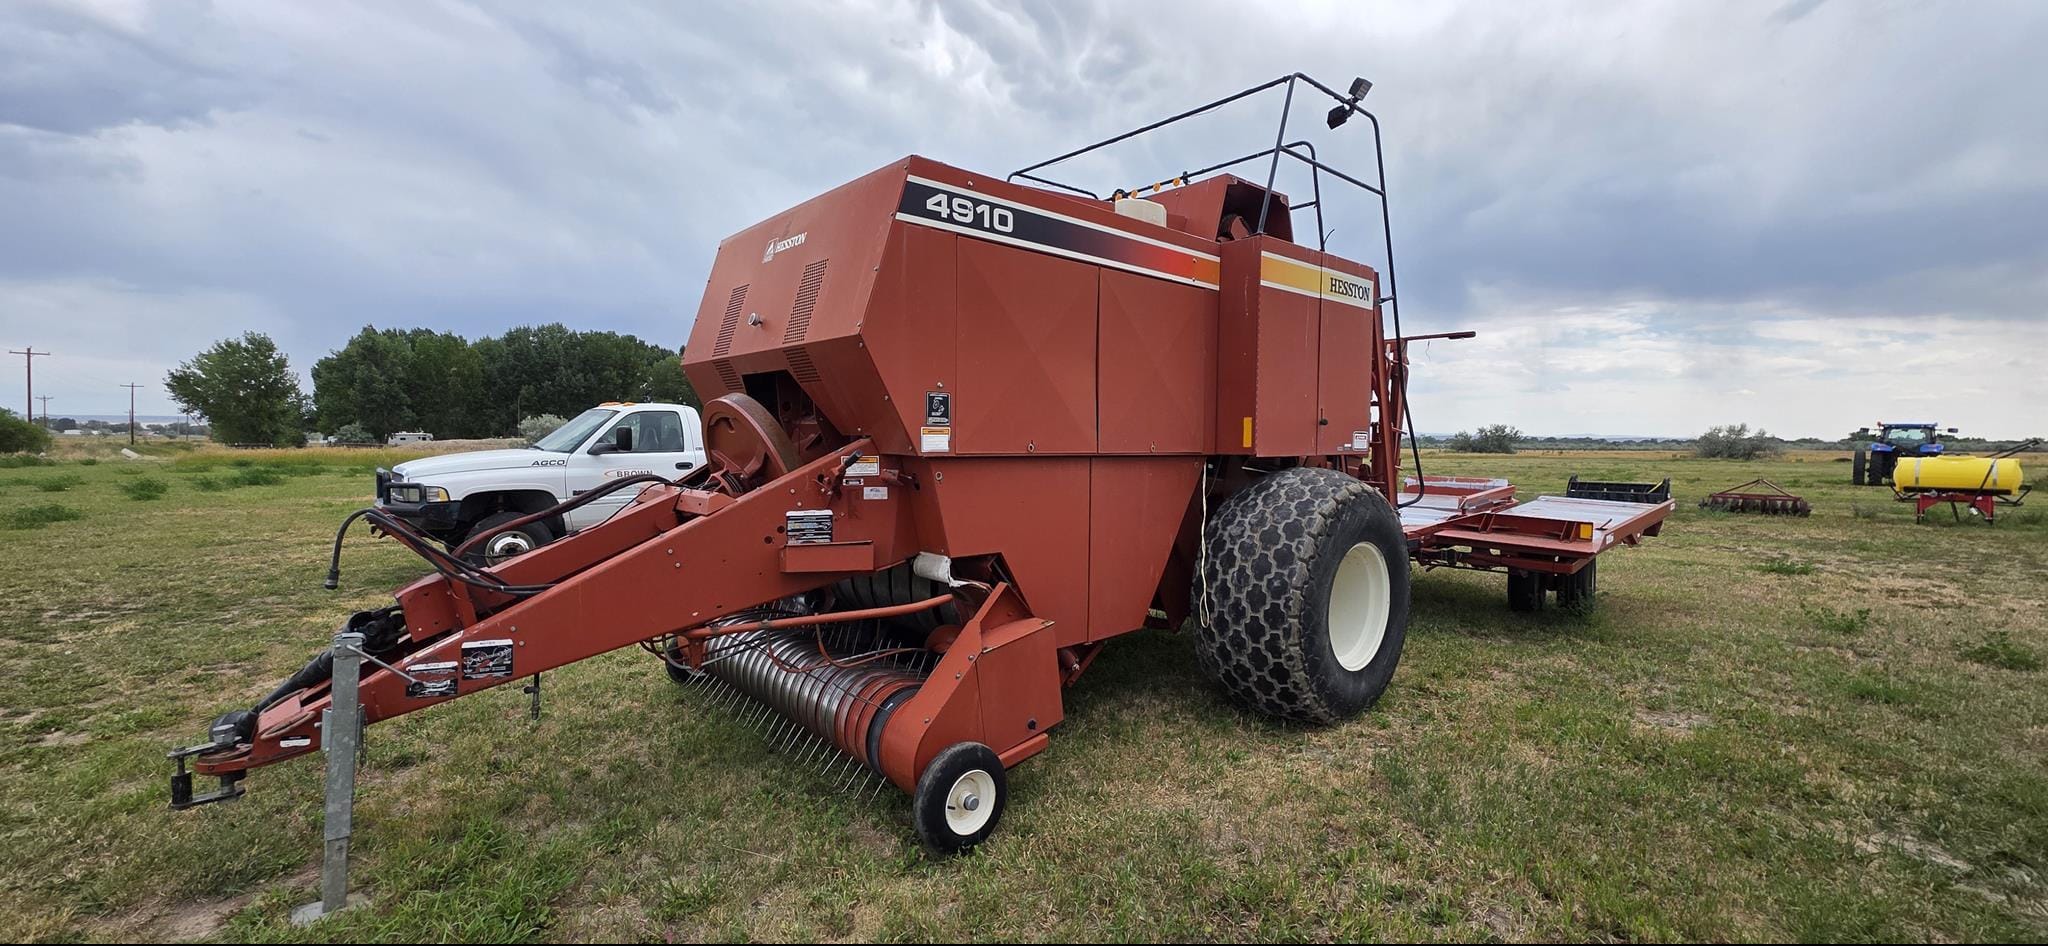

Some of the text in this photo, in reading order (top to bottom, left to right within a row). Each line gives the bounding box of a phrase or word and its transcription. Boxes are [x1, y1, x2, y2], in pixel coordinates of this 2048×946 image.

[926, 193, 1014, 233] 4910
[1330, 277, 1370, 302] HESSTON
[616, 470, 653, 478] BROWN
